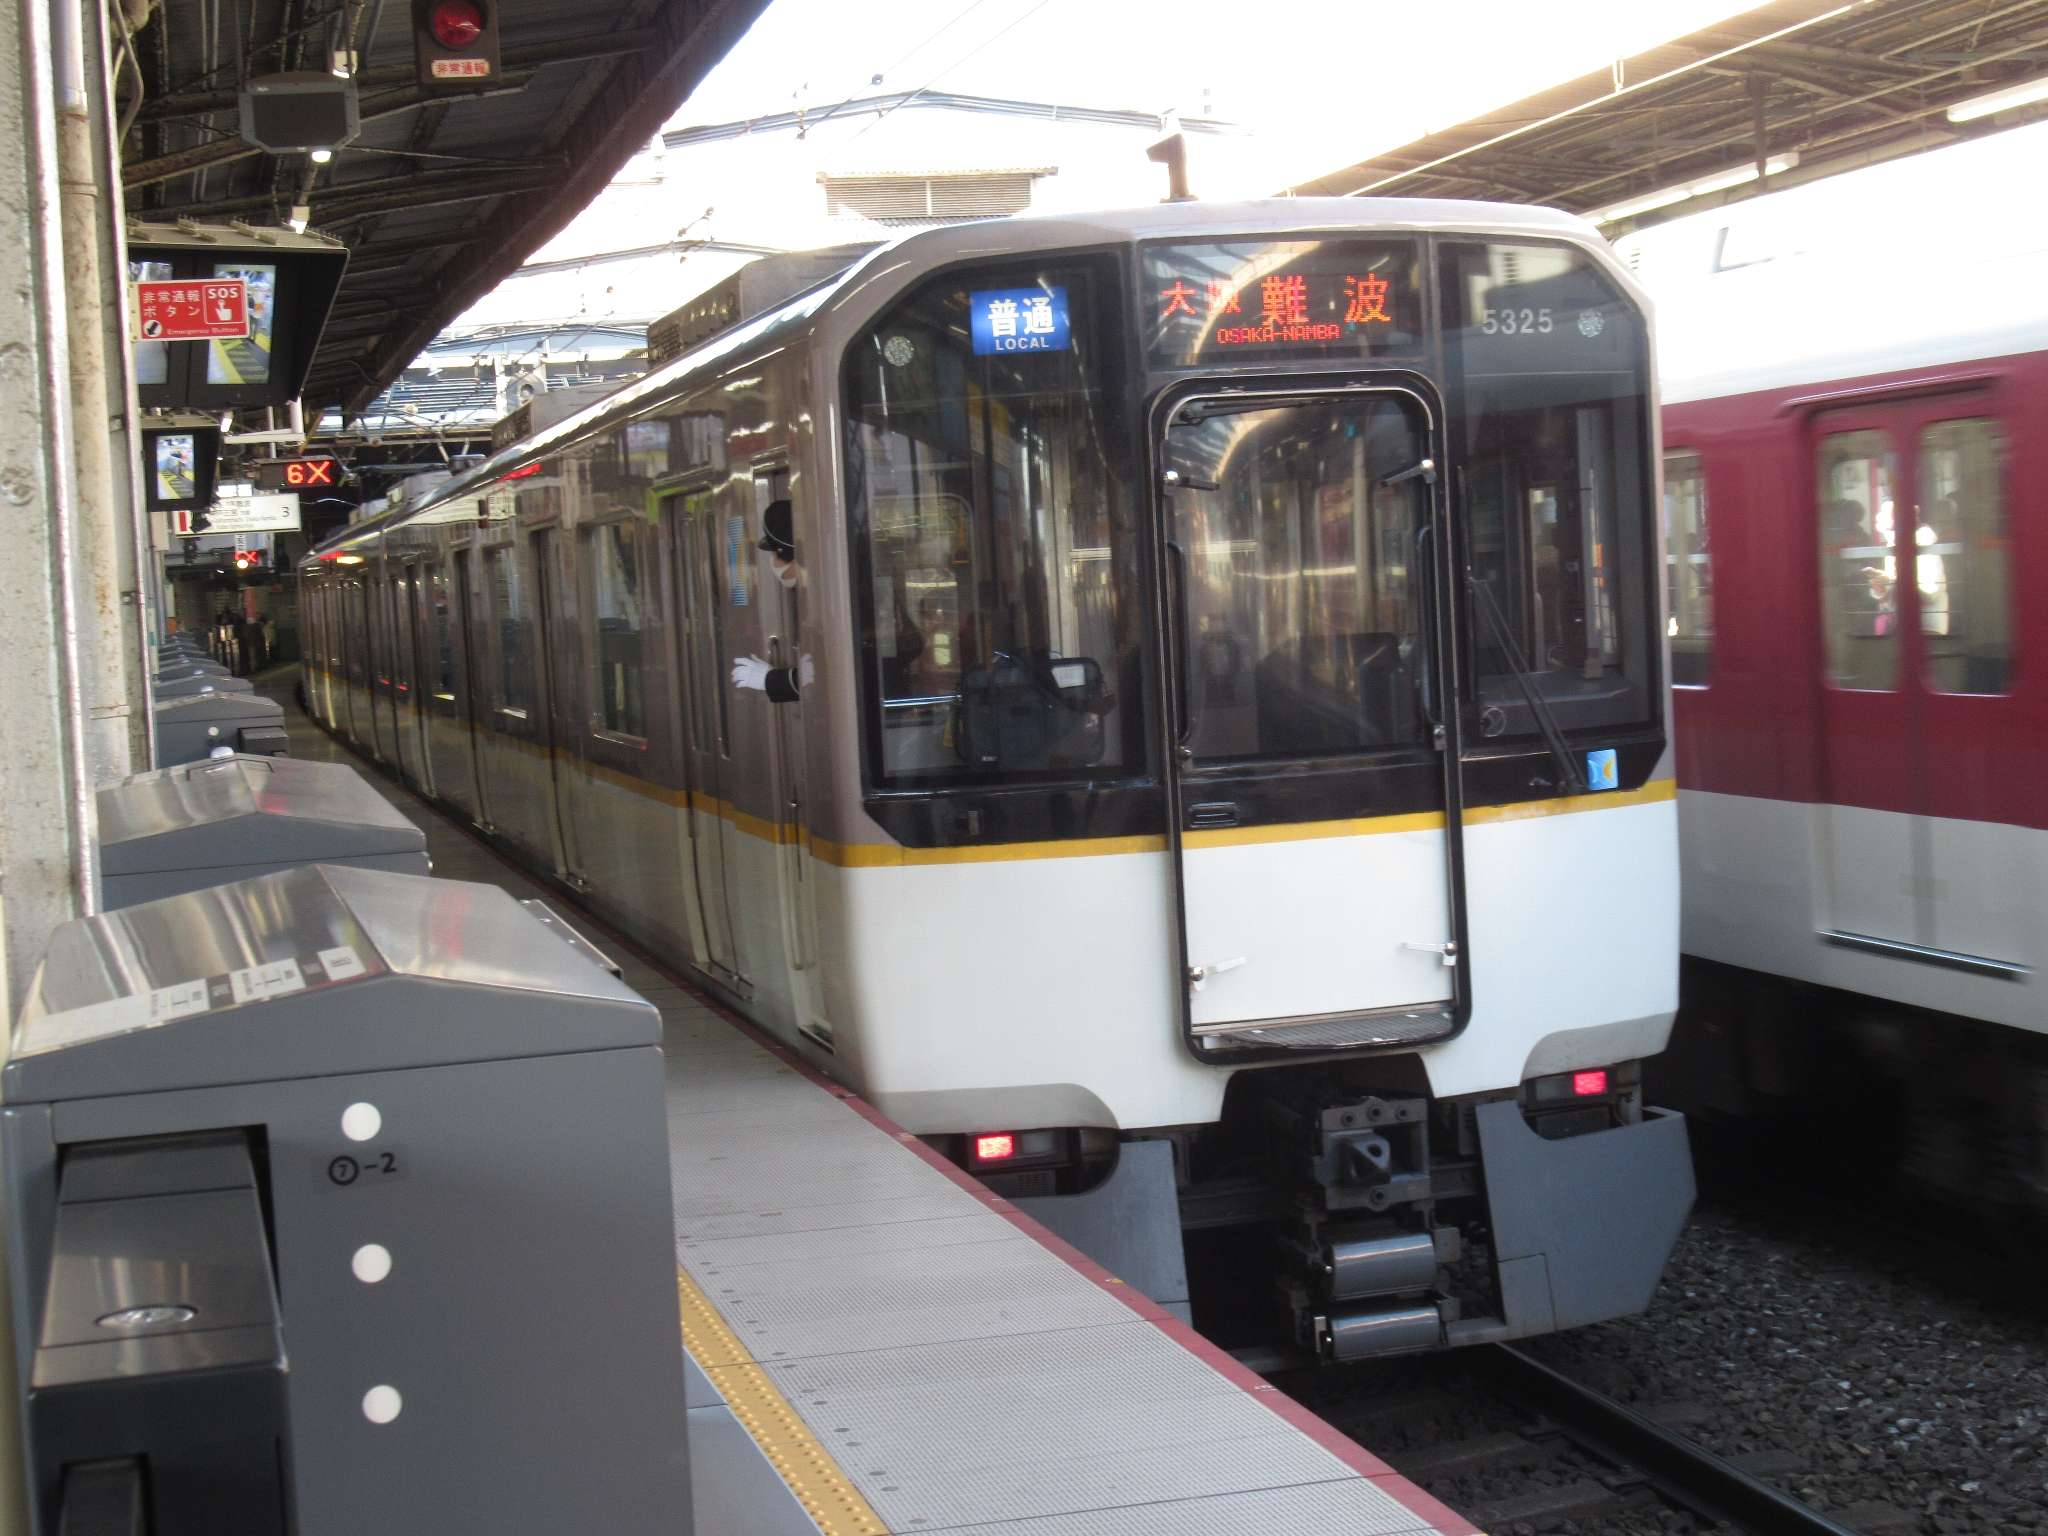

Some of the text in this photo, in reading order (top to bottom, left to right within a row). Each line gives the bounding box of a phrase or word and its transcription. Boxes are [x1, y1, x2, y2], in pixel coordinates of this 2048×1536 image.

[143, 290, 200, 303] 非常通報
[208, 287, 238, 299] SOS
[143, 305, 200, 318] ボタン
[987, 297, 1056, 337] 普通
[1481, 308, 1553, 335] 5325
[1216, 324, 1341, 344] OSAKA-NAMBA
[995, 337, 1049, 351] LOCAL
[281, 506, 290, 518] 3
